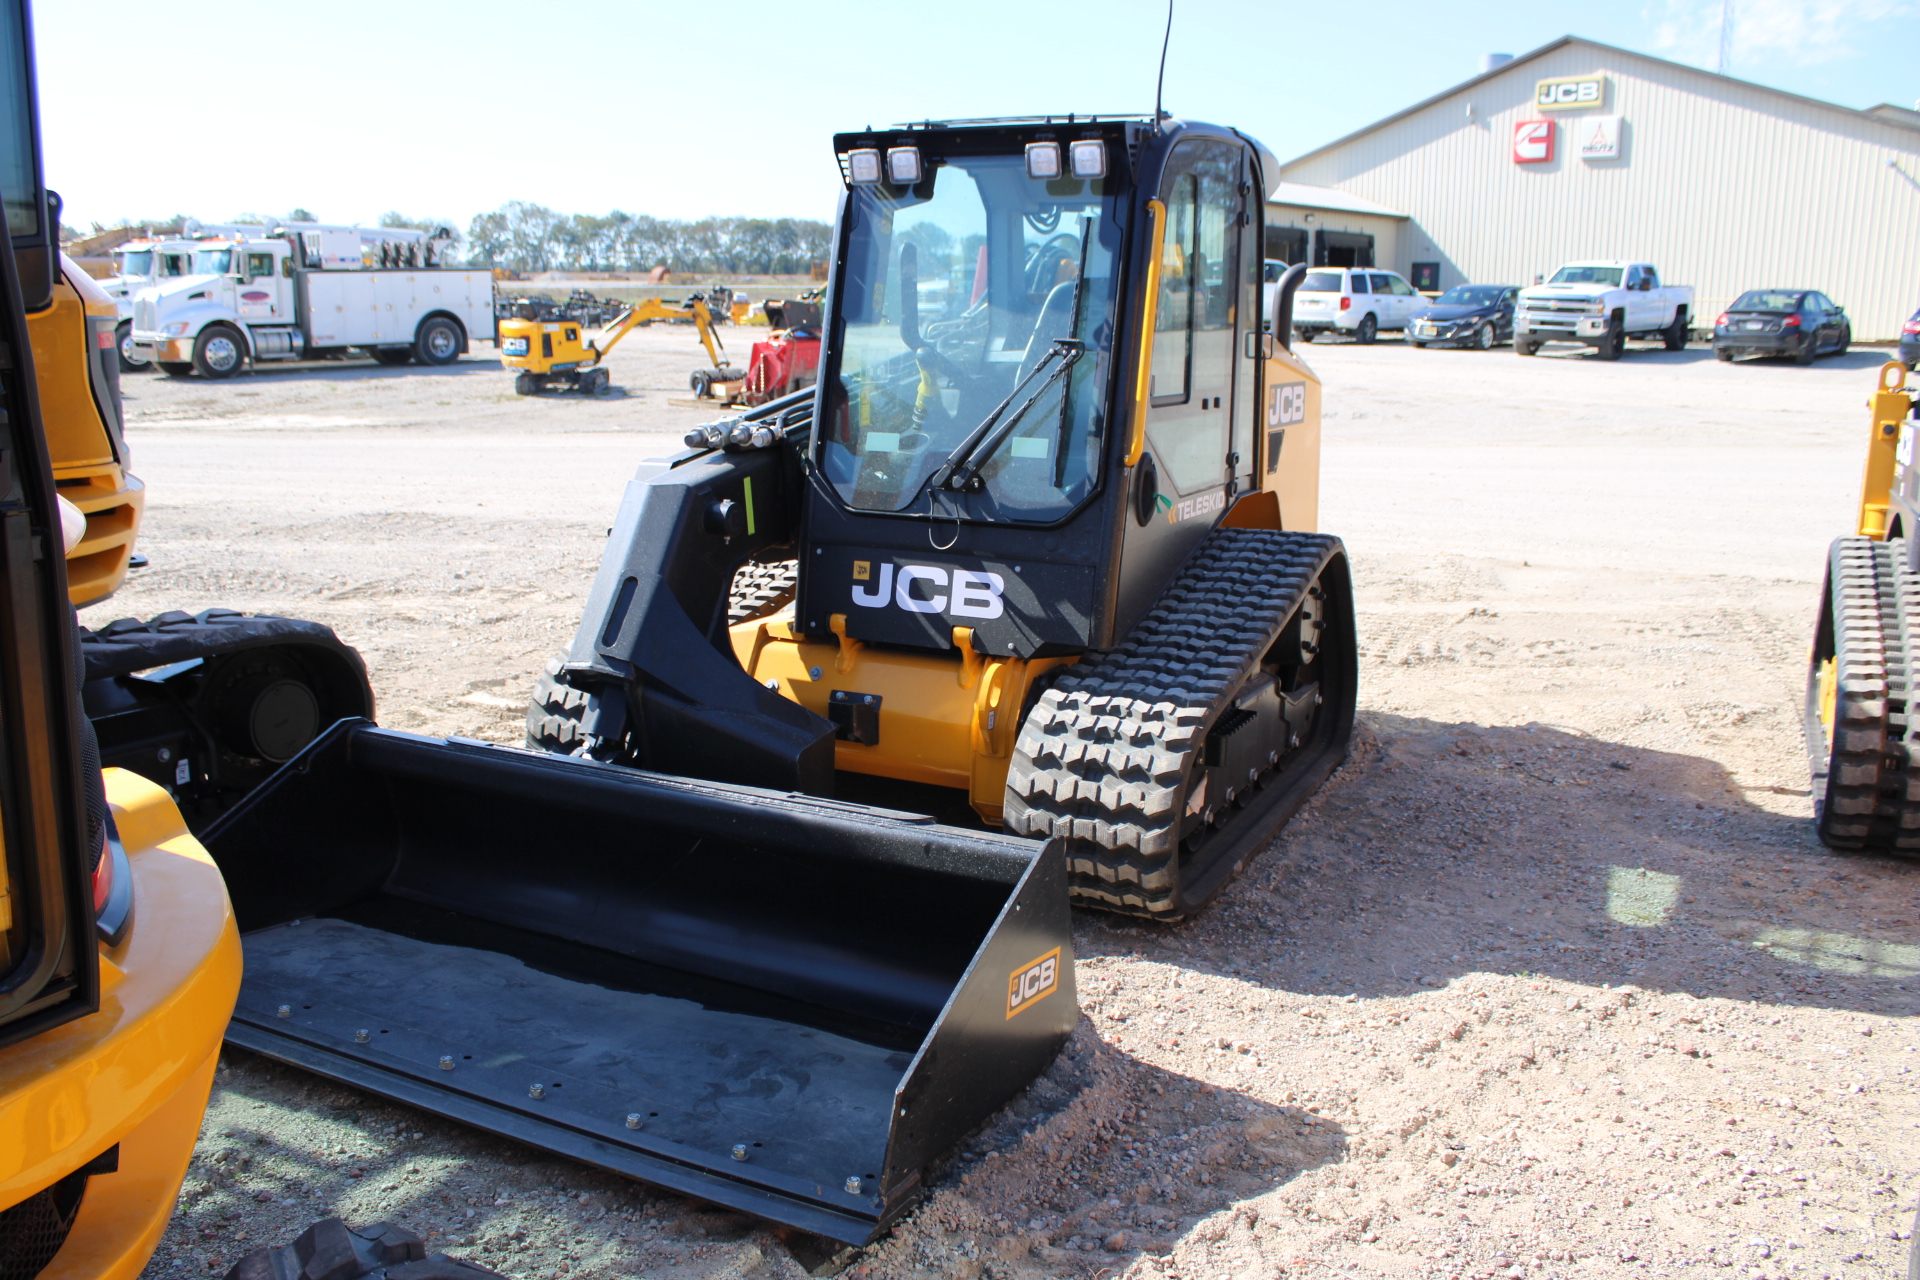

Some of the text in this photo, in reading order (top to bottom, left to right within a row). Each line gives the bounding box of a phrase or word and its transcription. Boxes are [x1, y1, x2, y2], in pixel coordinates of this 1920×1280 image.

[1539, 82, 1599, 104] JCB
[1269, 385, 1305, 426] JCB
[1177, 490, 1226, 522] TELESKID
[852, 563, 1005, 620] JCB
[1010, 957, 1056, 1007] JCB
